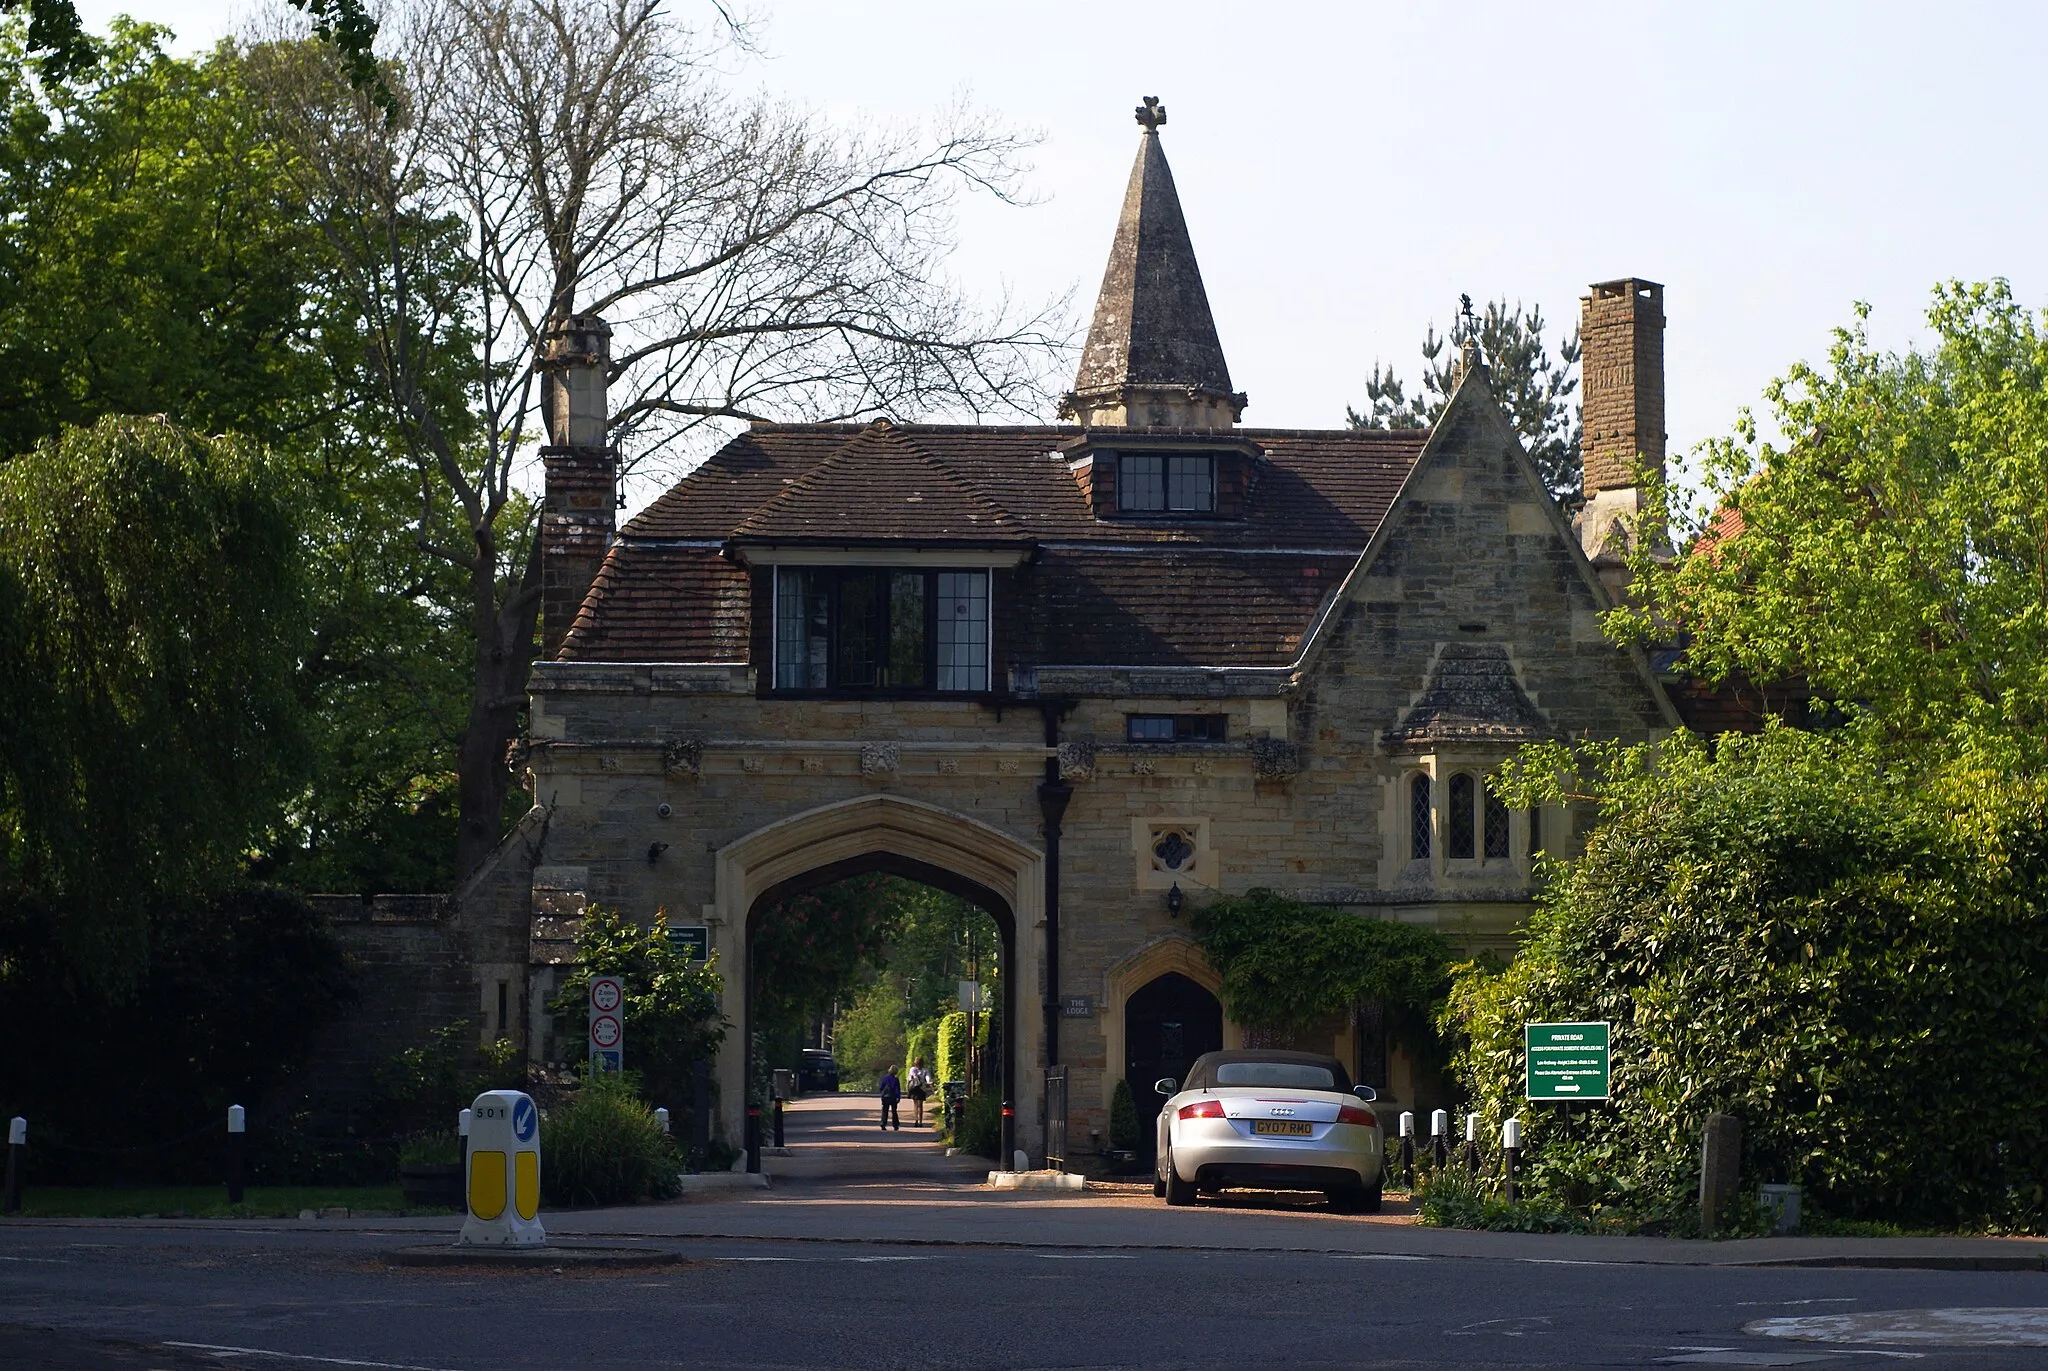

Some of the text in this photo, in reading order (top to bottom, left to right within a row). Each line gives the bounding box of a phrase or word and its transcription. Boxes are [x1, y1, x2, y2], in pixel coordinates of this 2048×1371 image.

[1070, 999, 1085, 1007] THE
[1066, 1007, 1089, 1015] LODGE
[476, 1108, 505, 1119] 501
[1257, 1122, 1312, 1134] GY07 RMO
